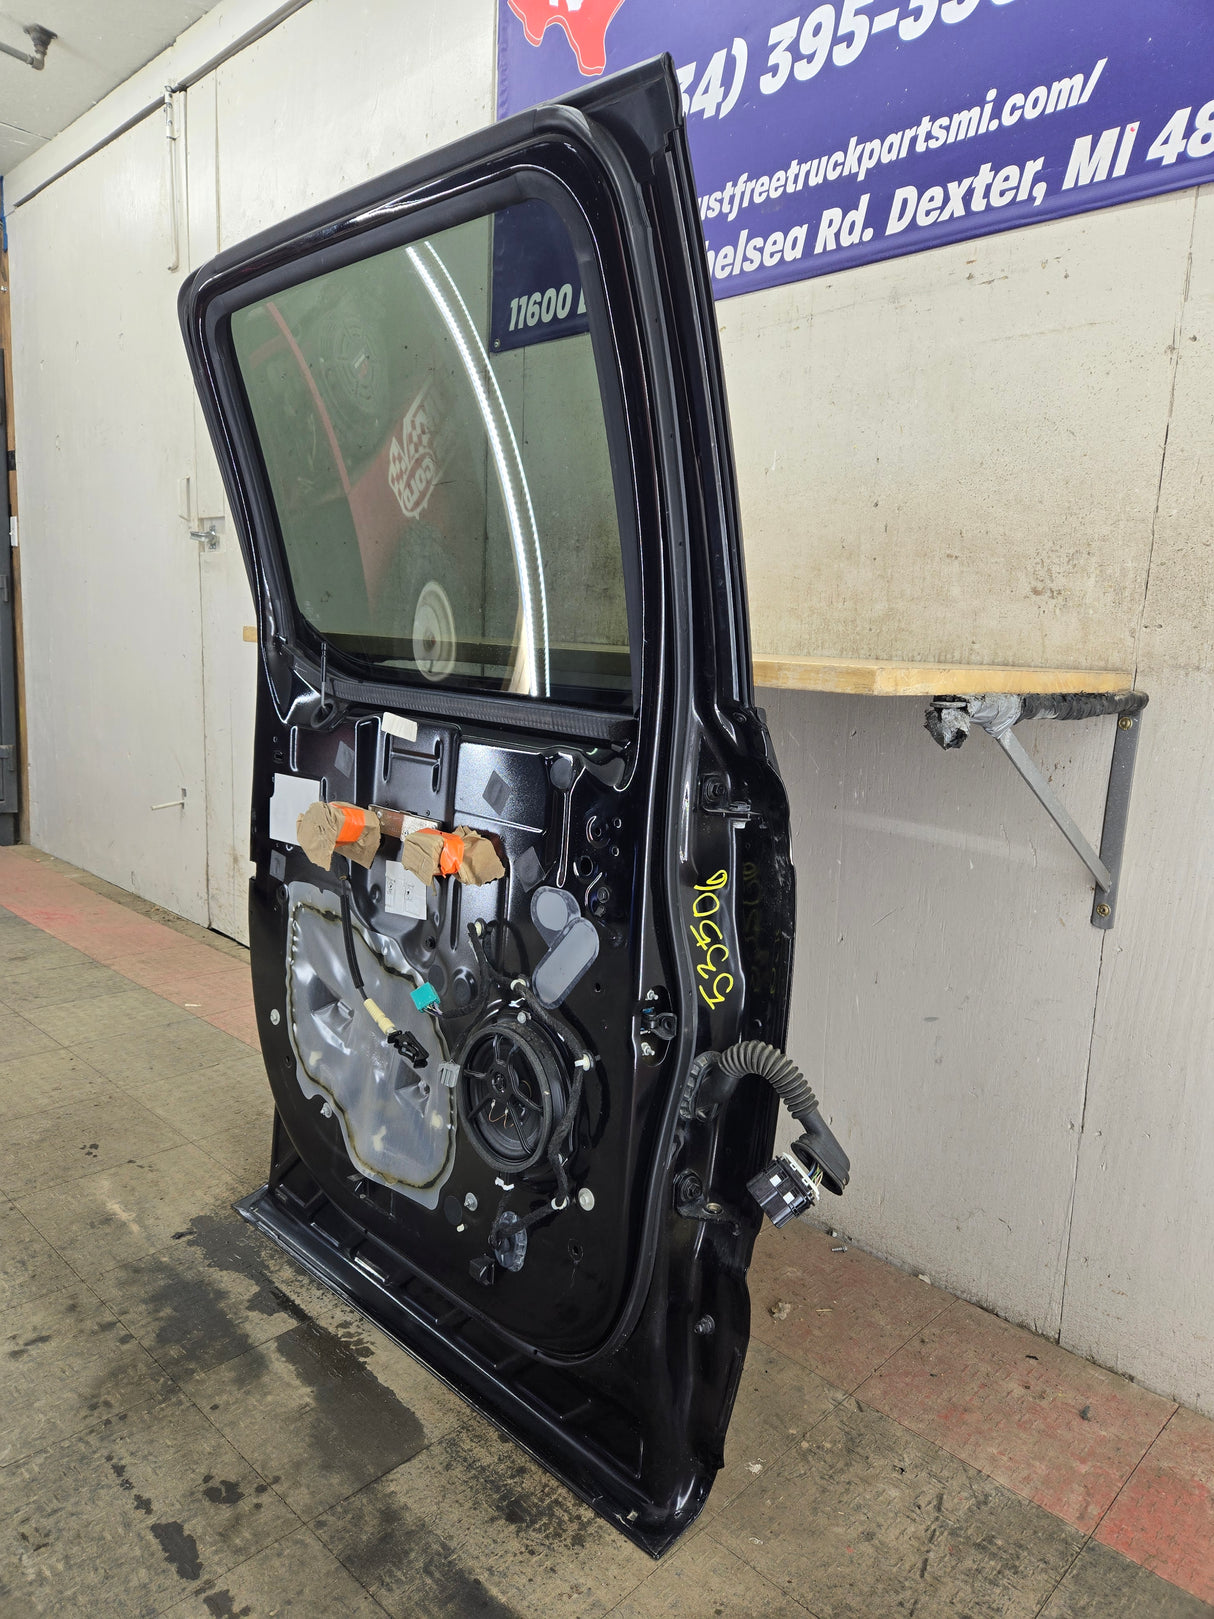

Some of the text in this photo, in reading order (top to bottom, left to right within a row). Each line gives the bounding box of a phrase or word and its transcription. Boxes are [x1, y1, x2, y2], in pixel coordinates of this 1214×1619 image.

[508, 283, 573, 332] 11600
[813, 193, 874, 255] Rd.
[885, 156, 1047, 236] Dexter,
[1061, 121, 1141, 191] MI
